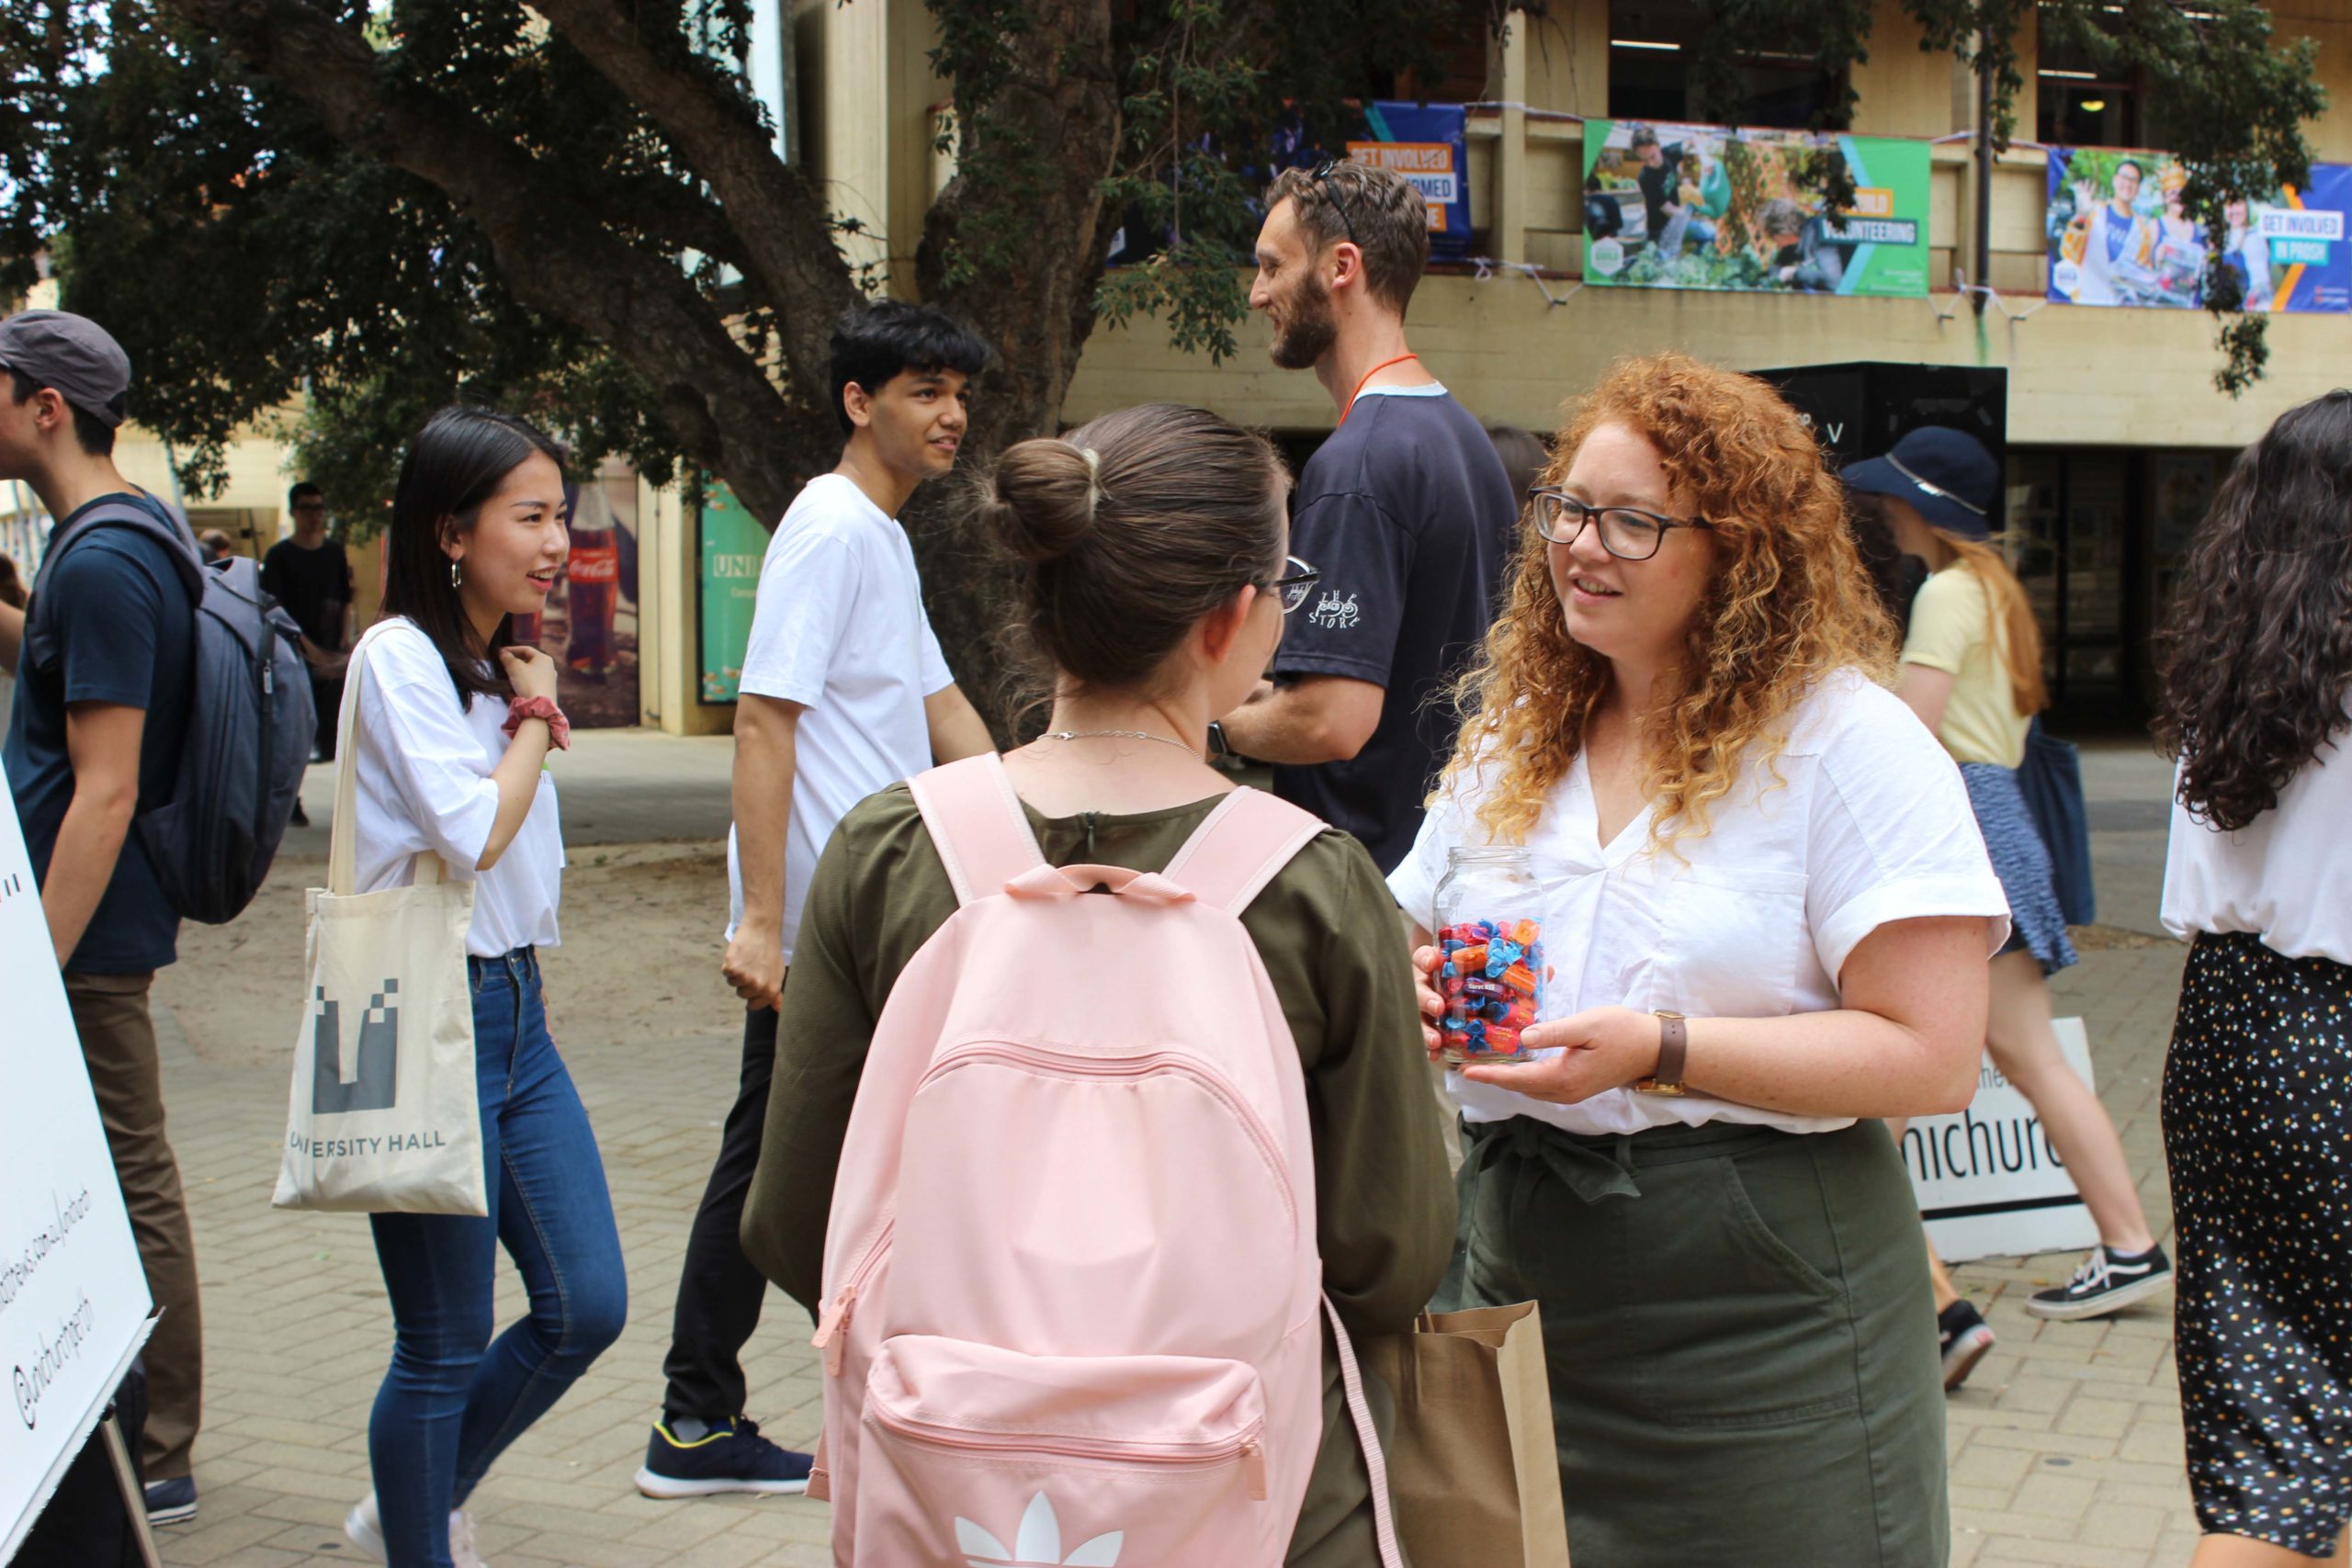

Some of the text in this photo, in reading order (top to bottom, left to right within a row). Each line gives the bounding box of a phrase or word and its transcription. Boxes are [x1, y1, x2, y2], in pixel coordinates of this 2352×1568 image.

[1379, 149, 1448, 169] INVOLVED
[2263, 214, 2338, 234] GET INVOLVED
[388, 1130, 447, 1152] HALL
